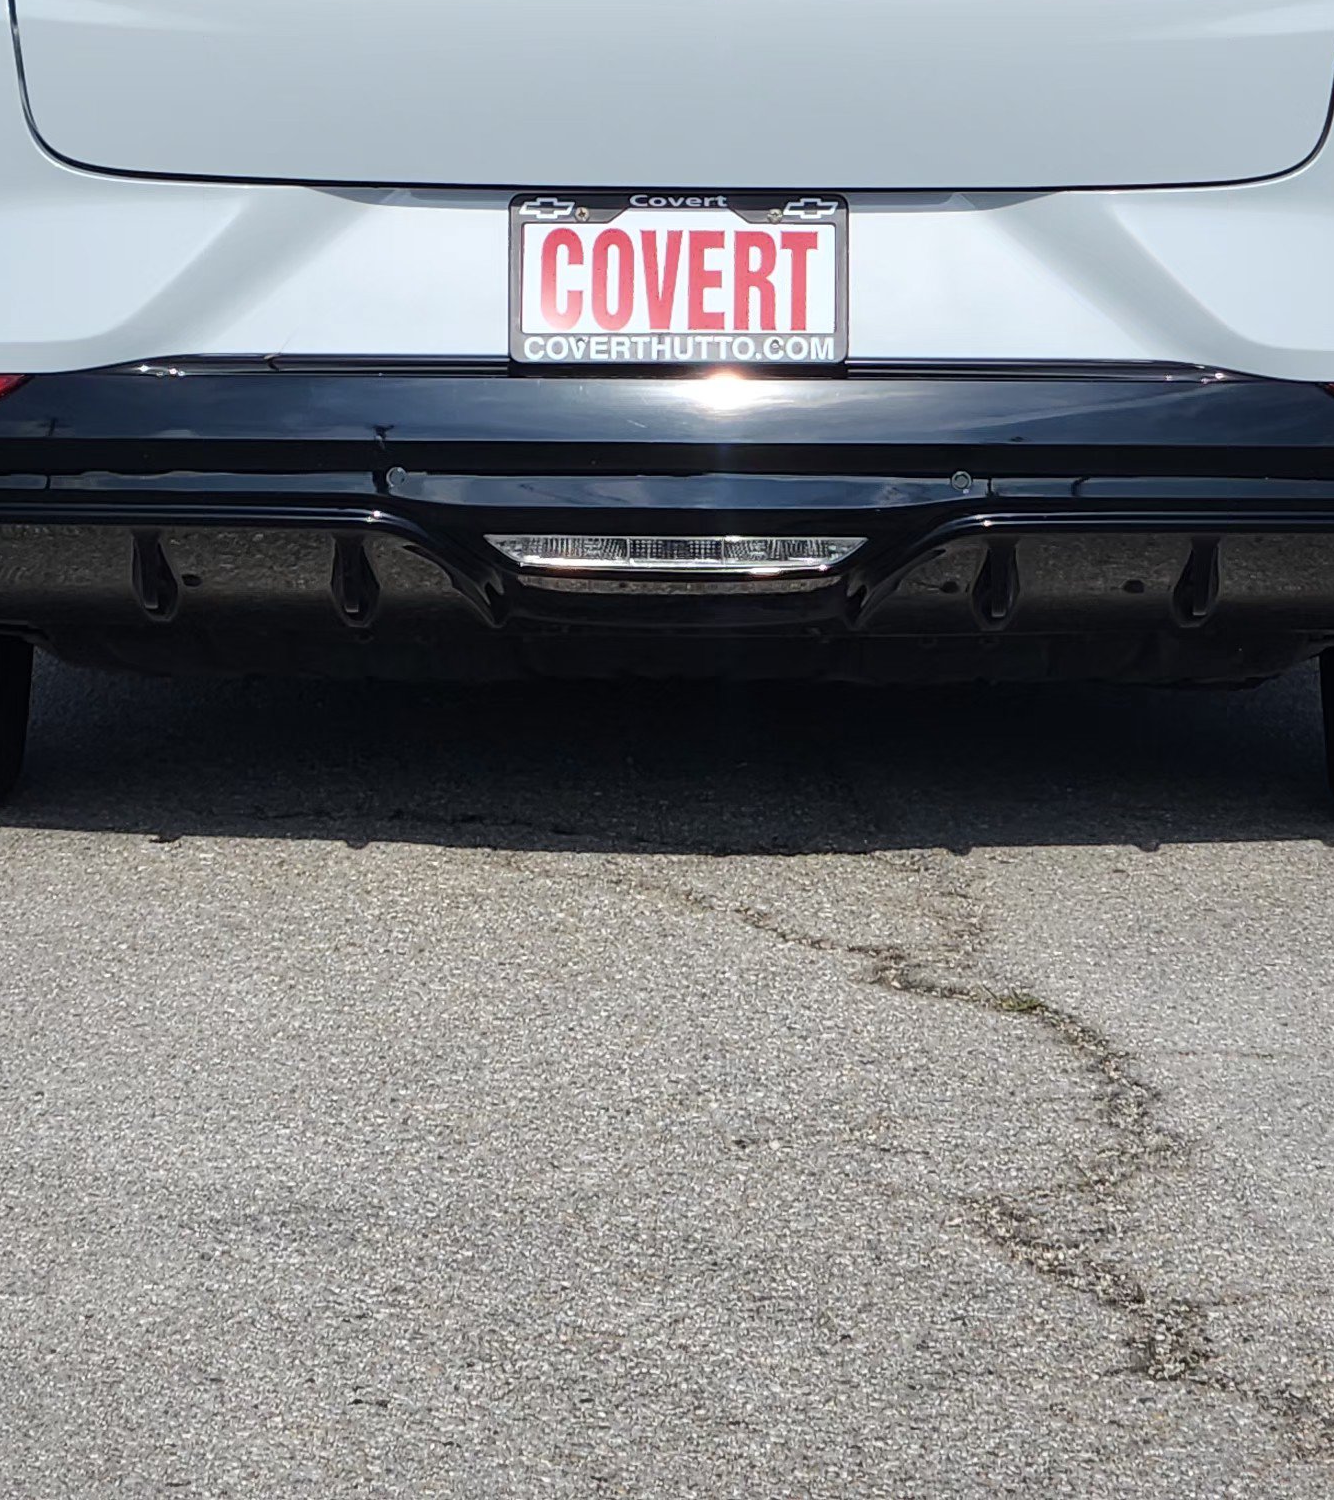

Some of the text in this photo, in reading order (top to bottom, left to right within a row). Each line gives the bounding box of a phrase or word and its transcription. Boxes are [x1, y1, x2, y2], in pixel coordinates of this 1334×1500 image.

[629, 194, 728, 208] Covert
[540, 227, 819, 331] COVERT
[523, 336, 835, 361] COVERTHUTTO.COM
